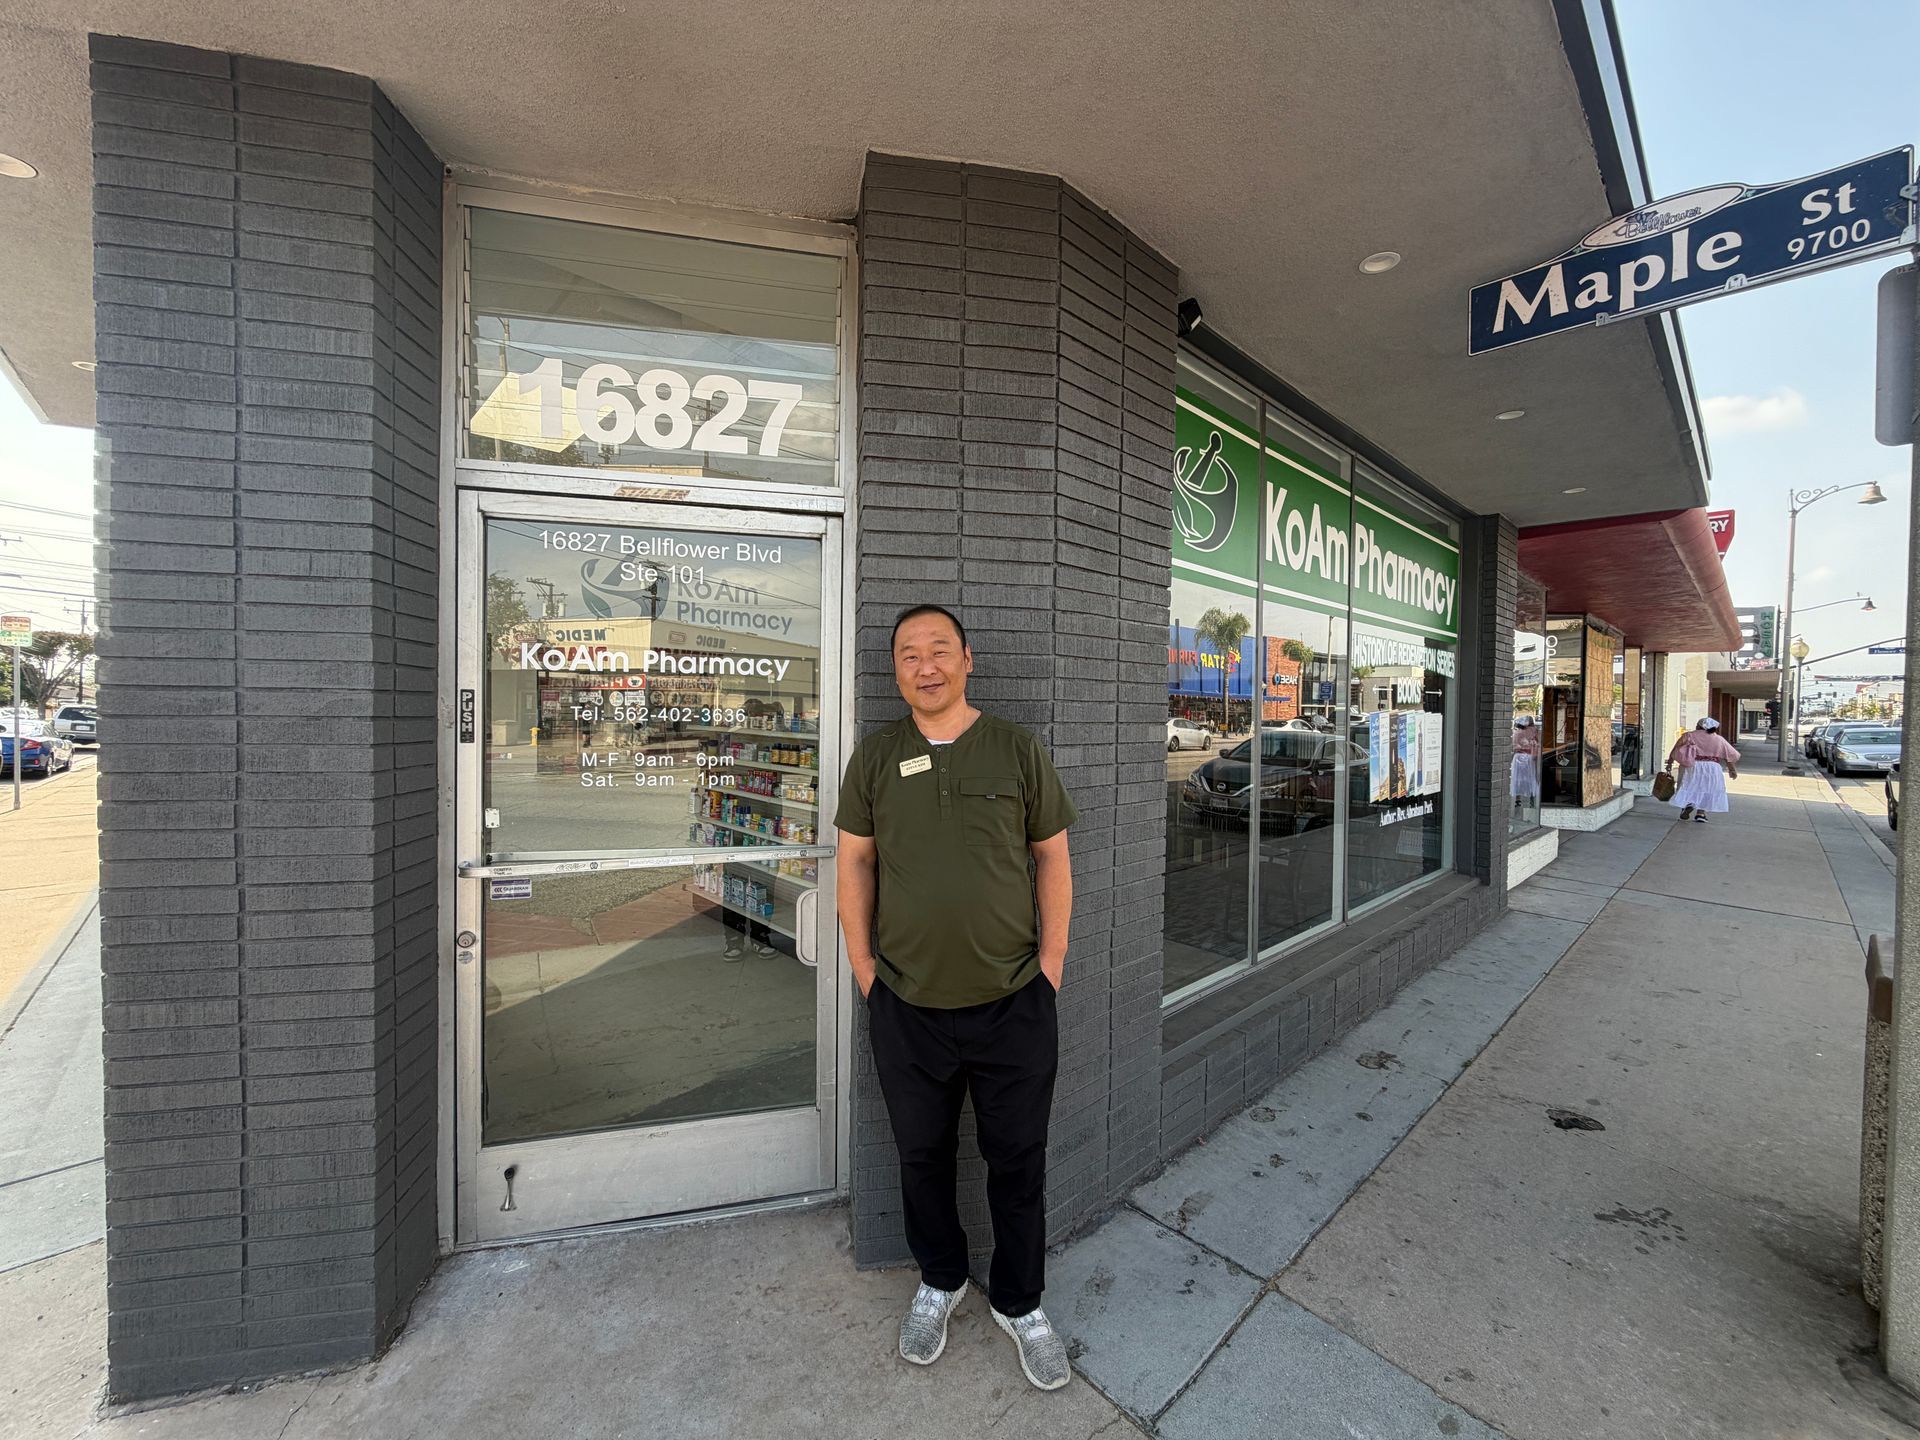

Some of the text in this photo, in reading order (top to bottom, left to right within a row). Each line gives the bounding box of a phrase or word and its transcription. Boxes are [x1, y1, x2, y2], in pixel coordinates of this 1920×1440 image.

[1801, 181, 1858, 227] St
[1786, 218, 1871, 260] 9700
[1492, 227, 1743, 335] Maple
[519, 358, 803, 457] 16827
[538, 530, 783, 564] 16827 Bellflower Blvd
[1265, 480, 1456, 626] KoAm Pharmacy
[620, 562, 704, 585] Ste 101
[676, 577, 759, 606] KoAm
[676, 603, 793, 636] Pharmacy
[521, 642, 791, 682] KoAm Pharmacy
[1353, 632, 1455, 679] HISTORY OF REDEMPTION SERIES
[1546, 635, 1558, 686] OPEN
[1397, 677, 1422, 704] BOOKS
[462, 691, 473, 733] PUSH
[570, 706, 746, 723] Tel: 562-402-3636
[580, 772, 620, 787] Sat.
[634, 772, 675, 787] 9am
[697, 773, 735, 792] 1pm
[581, 752, 620, 768] M-F
[634, 753, 675, 768] 9am
[696, 752, 735, 773] 6pm
